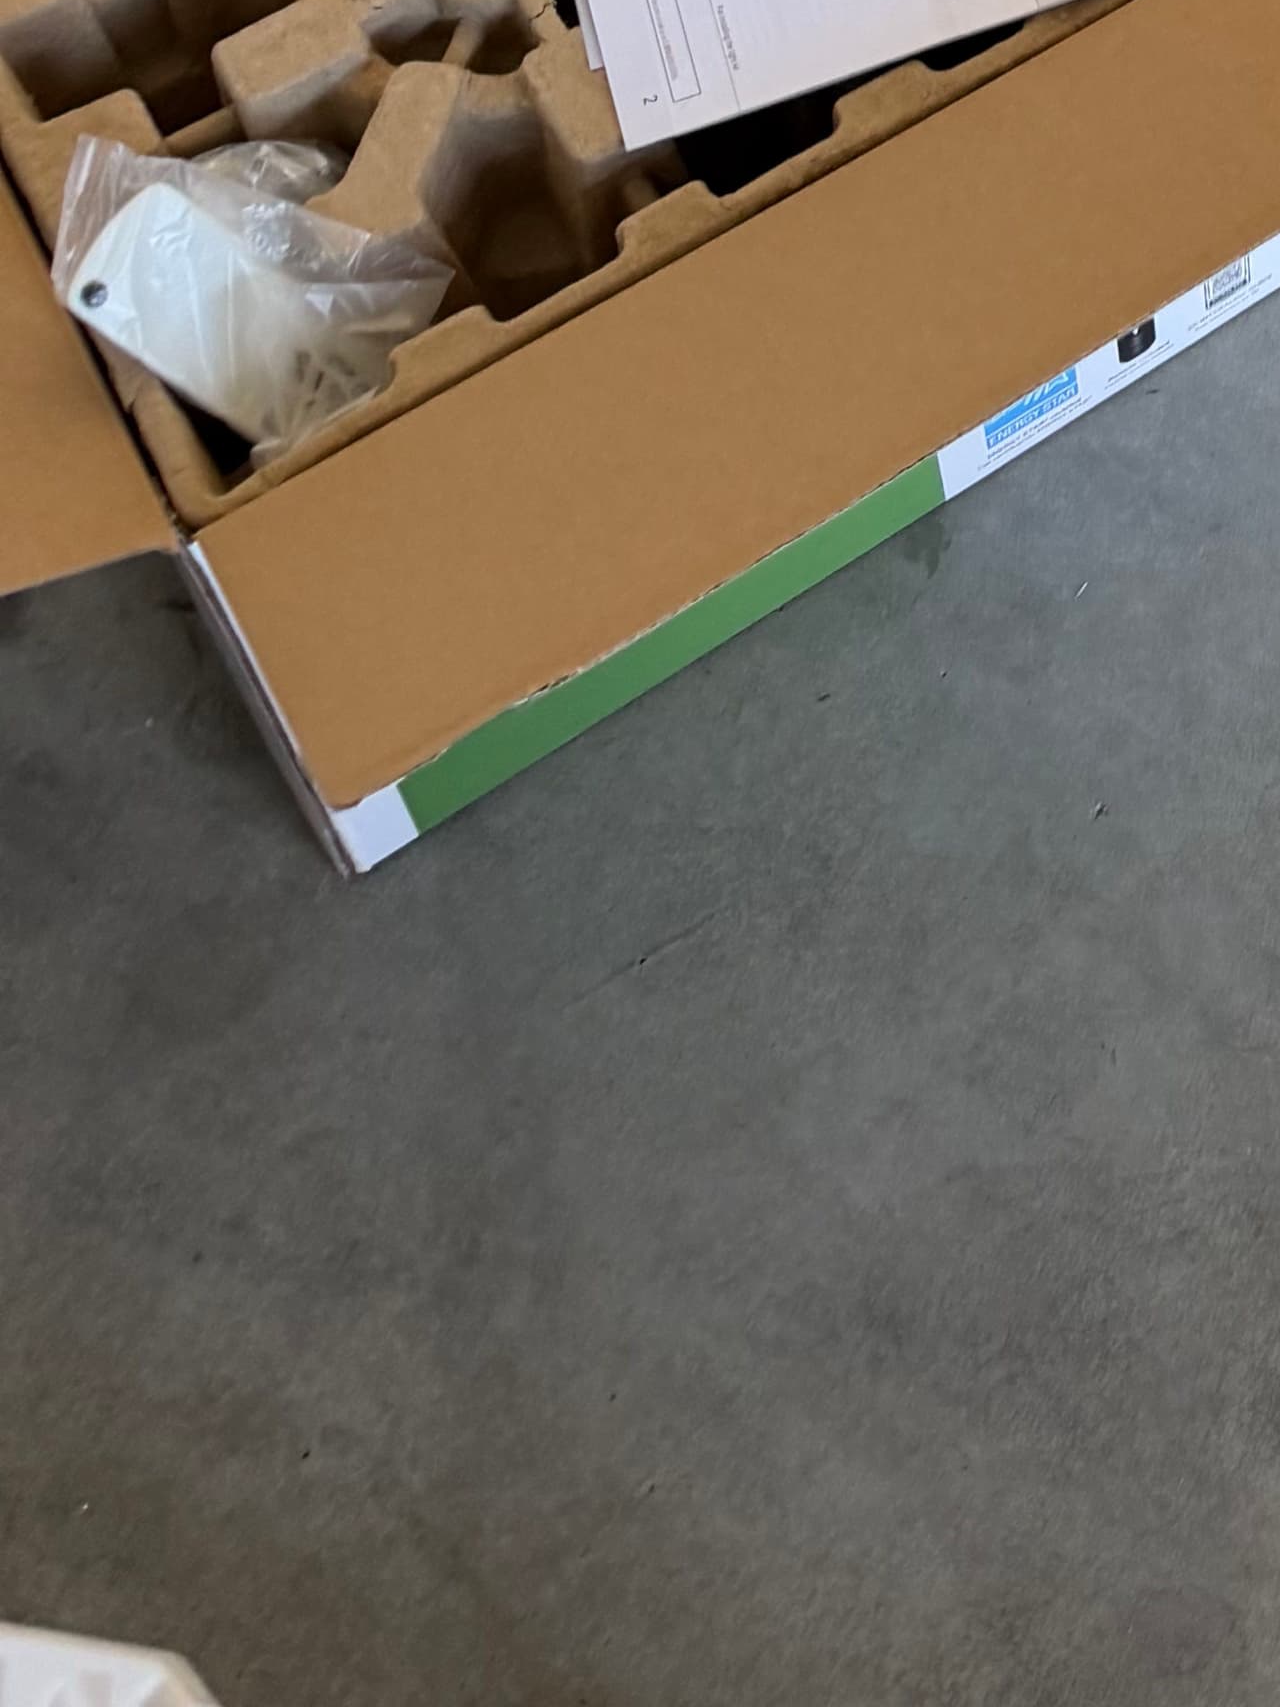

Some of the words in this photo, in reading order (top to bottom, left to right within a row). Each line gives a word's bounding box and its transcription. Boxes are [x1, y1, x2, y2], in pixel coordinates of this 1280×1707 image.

[643, 94, 658, 106] 2
[987, 408, 1040, 448] ENERGY
[1041, 385, 1077, 415] STAR
